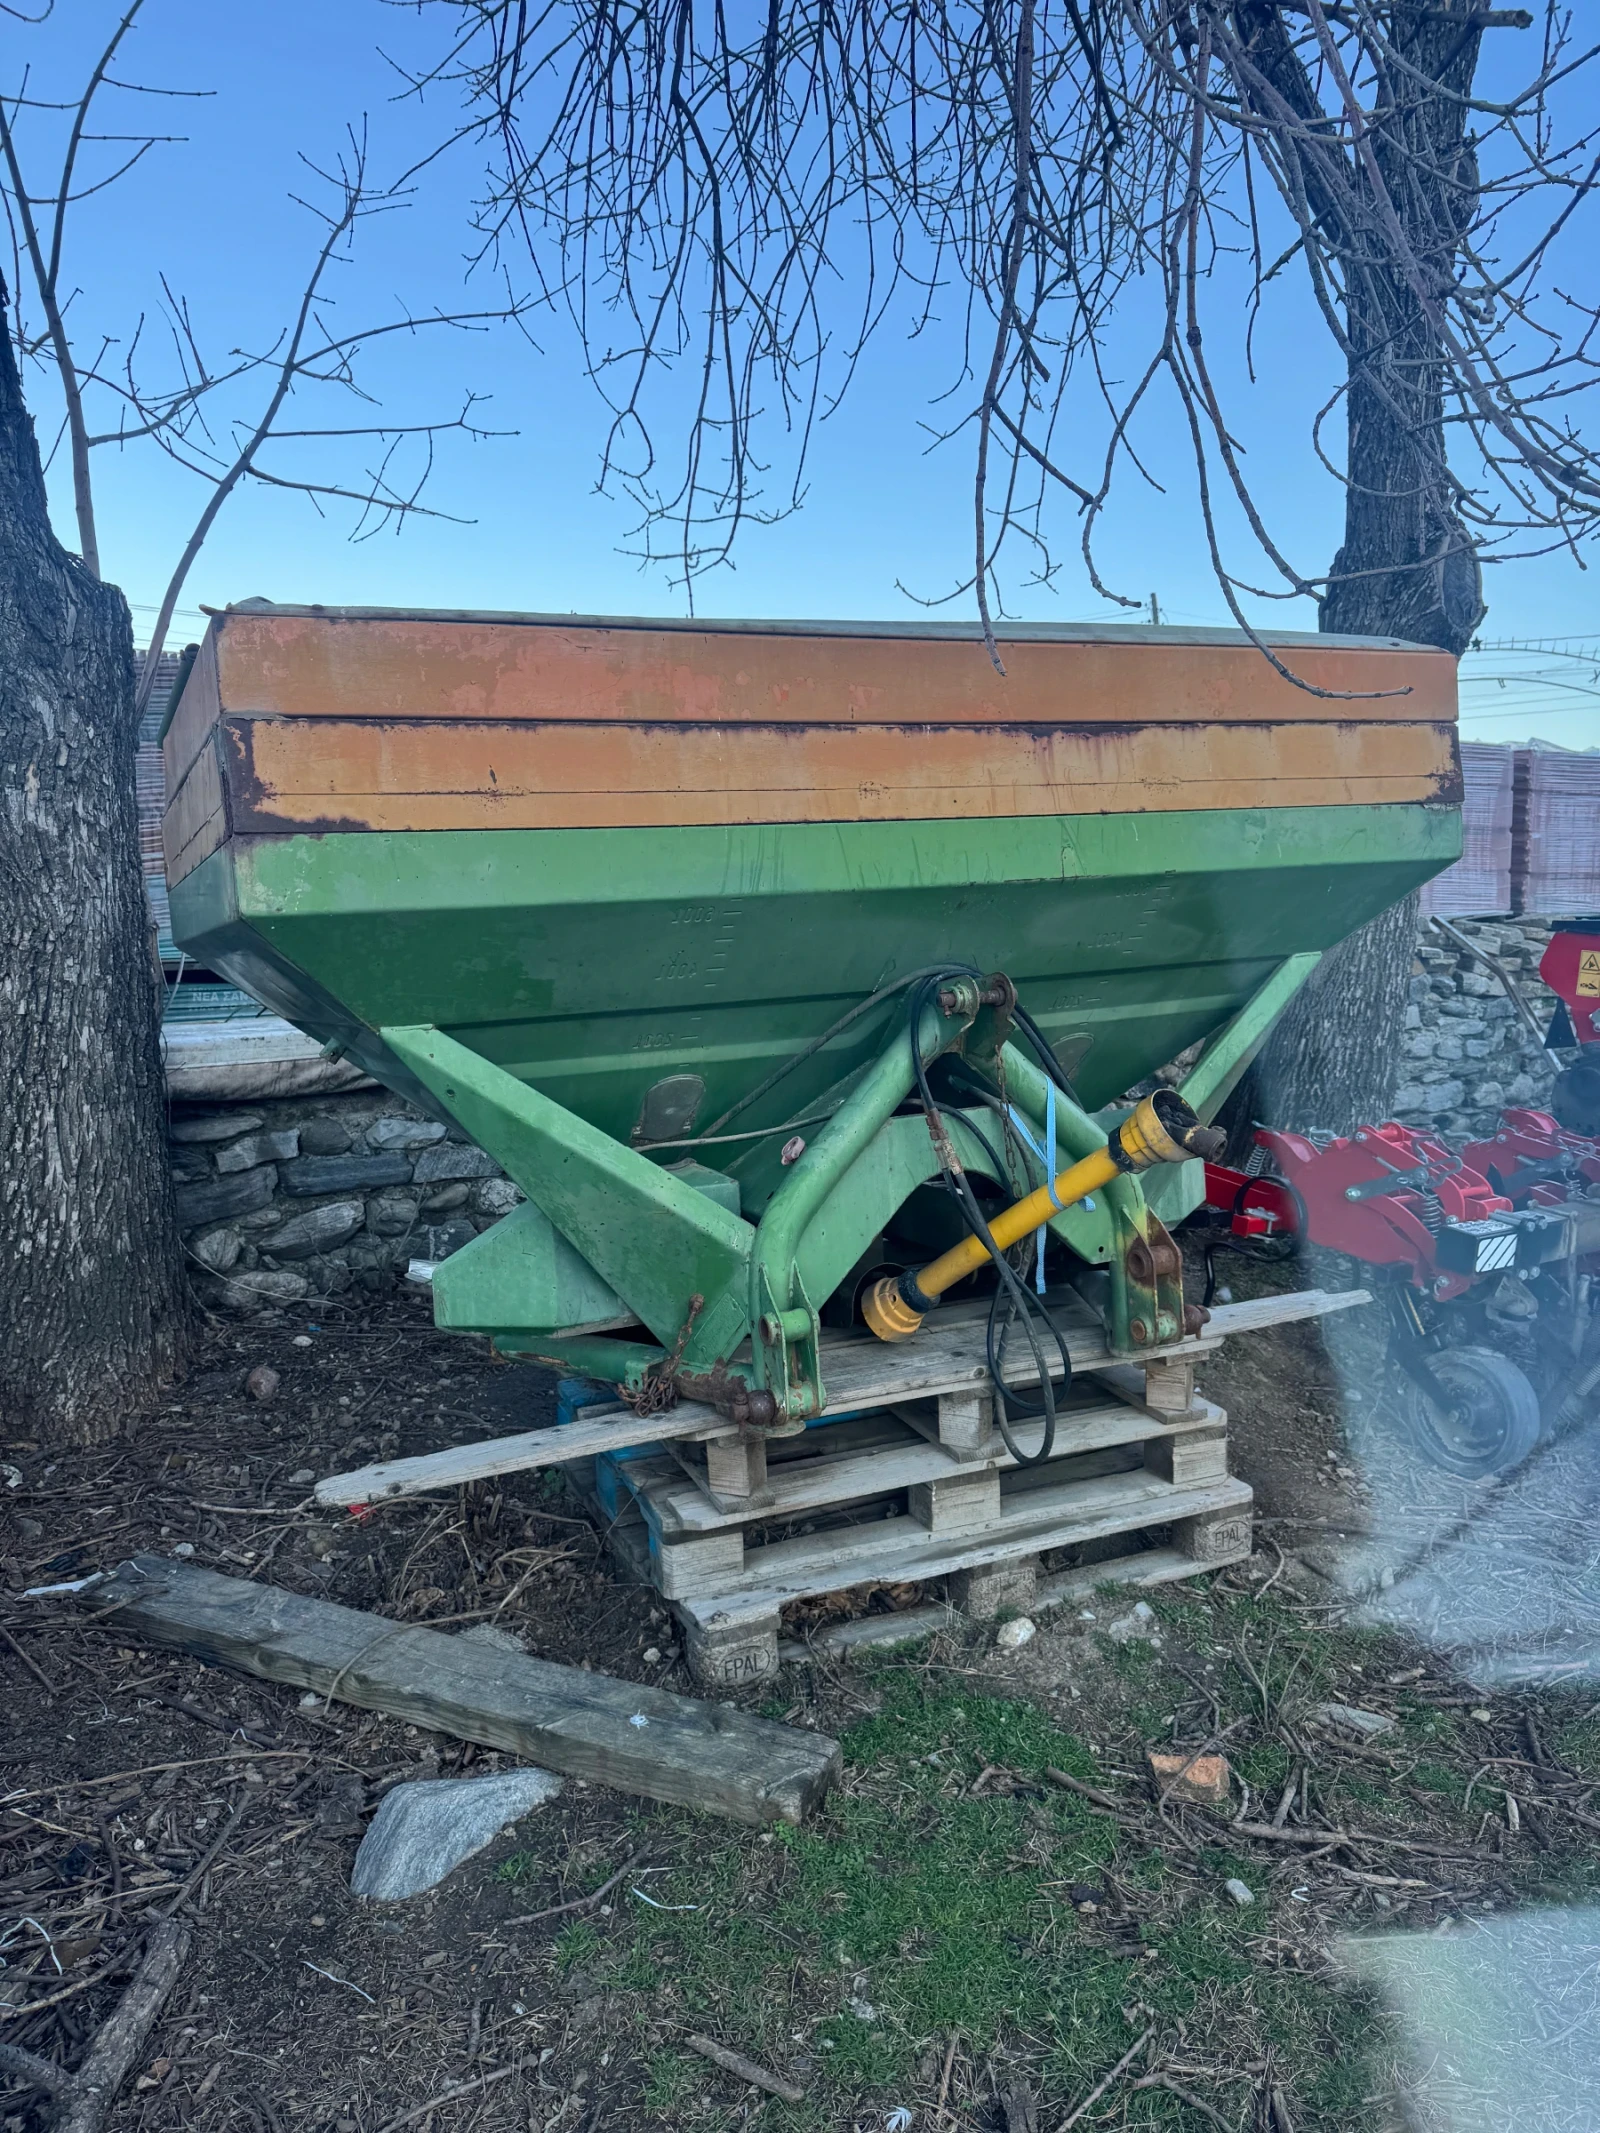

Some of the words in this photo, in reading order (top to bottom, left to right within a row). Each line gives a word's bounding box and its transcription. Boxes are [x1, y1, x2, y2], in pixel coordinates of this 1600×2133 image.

[192, 991, 219, 1002] ΝΕΑ
[223, 991, 252, 1002] ΣΑΝ
[1214, 1525, 1240, 1549] EPAL
[724, 1652, 764, 1682] EPAL
